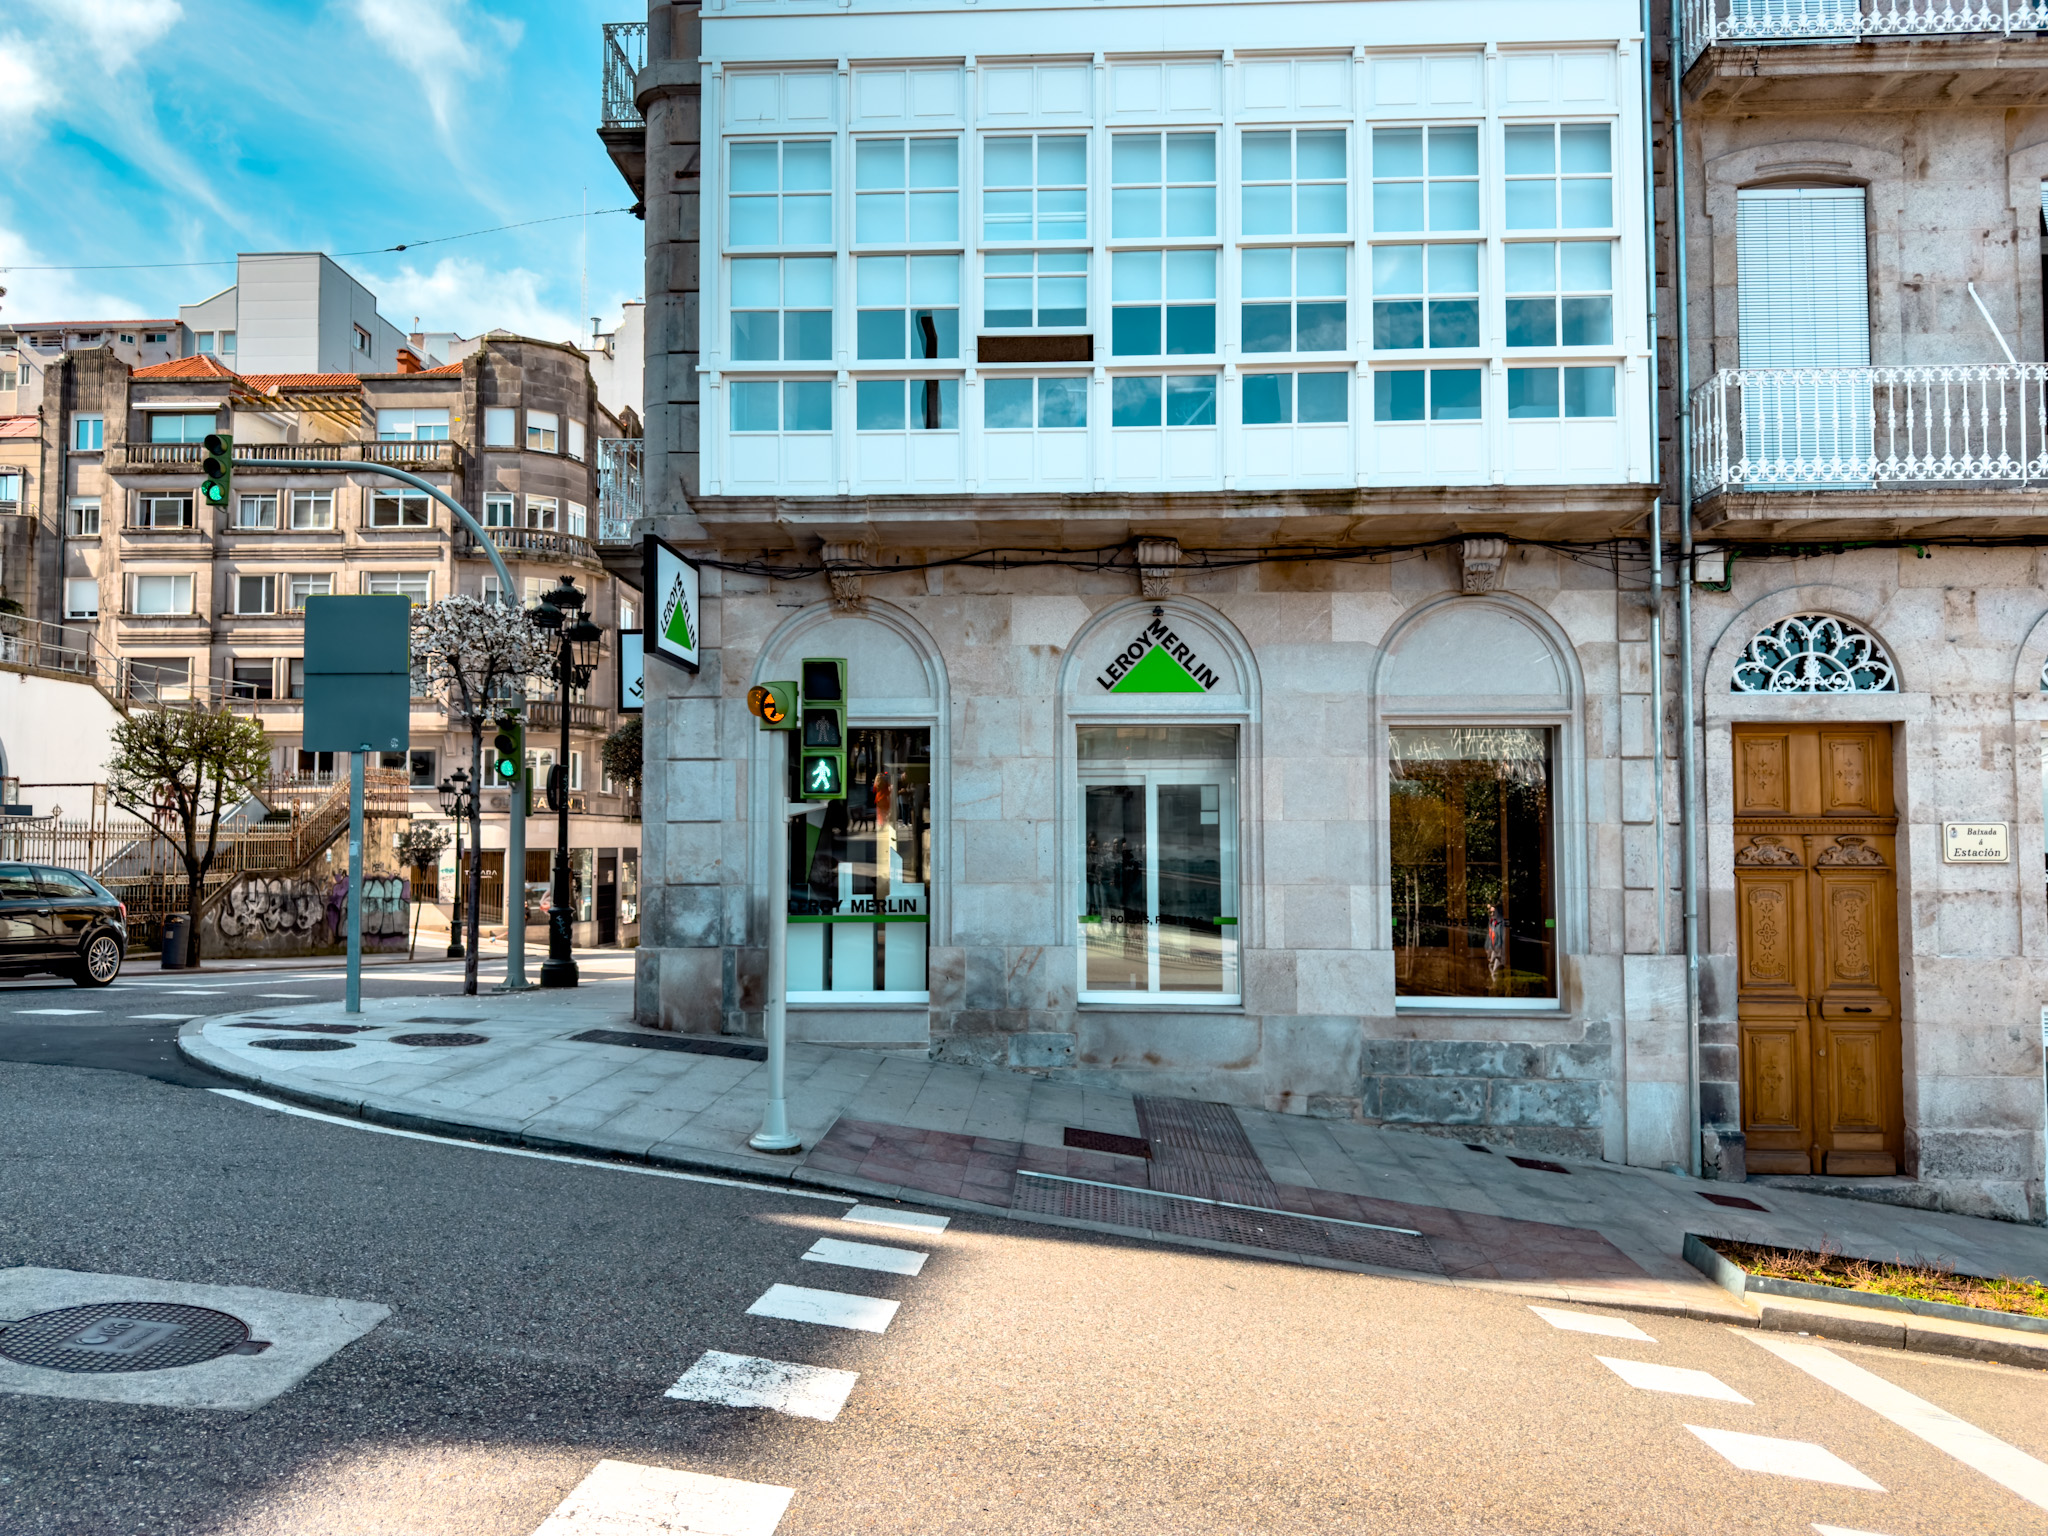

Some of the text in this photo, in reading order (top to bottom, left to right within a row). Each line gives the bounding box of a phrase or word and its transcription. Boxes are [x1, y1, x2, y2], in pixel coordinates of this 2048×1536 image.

[660, 571, 697, 650] LEROY MERLIN
[1096, 617, 1220, 691] LEROY MERLIN
[1967, 827, 1997, 836] Baixada
[1953, 847, 2001, 857] Estación
[787, 899, 917, 913] LEROY MERLIN
